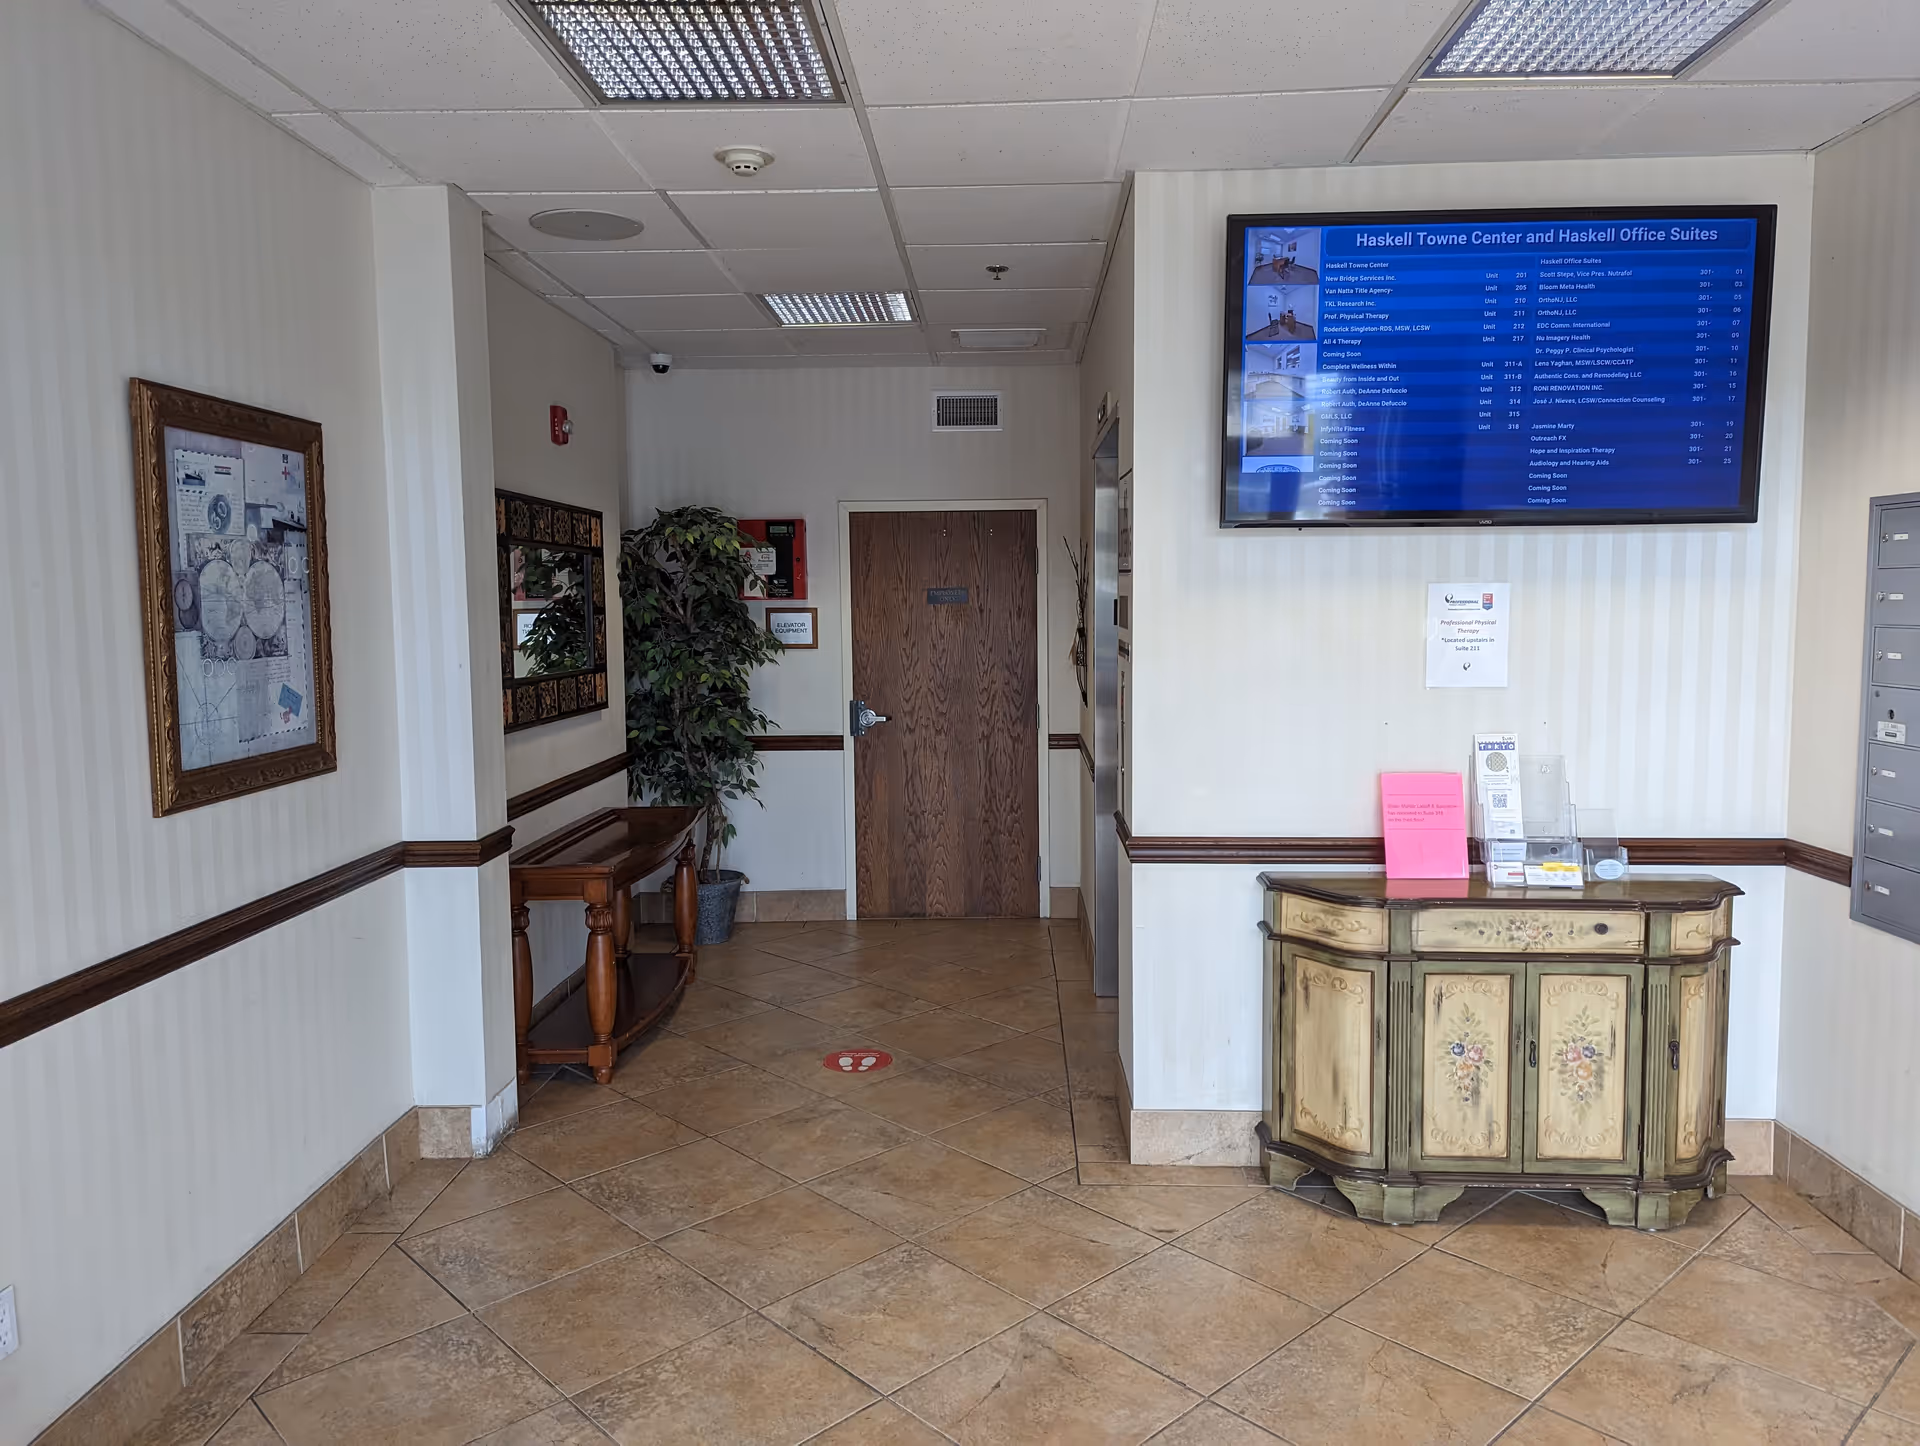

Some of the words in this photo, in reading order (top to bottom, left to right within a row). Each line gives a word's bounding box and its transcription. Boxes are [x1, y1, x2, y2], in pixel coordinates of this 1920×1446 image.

[1357, 232, 1412, 247] Haskell
[1416, 231, 1467, 245] Towne
[1472, 230, 1522, 244] Center
[1526, 229, 1554, 243] and
[1559, 228, 1615, 242] Haskell
[1620, 227, 1666, 241] Office
[1670, 226, 1718, 241] Suites
[1320, 437, 1342, 445] Coming
